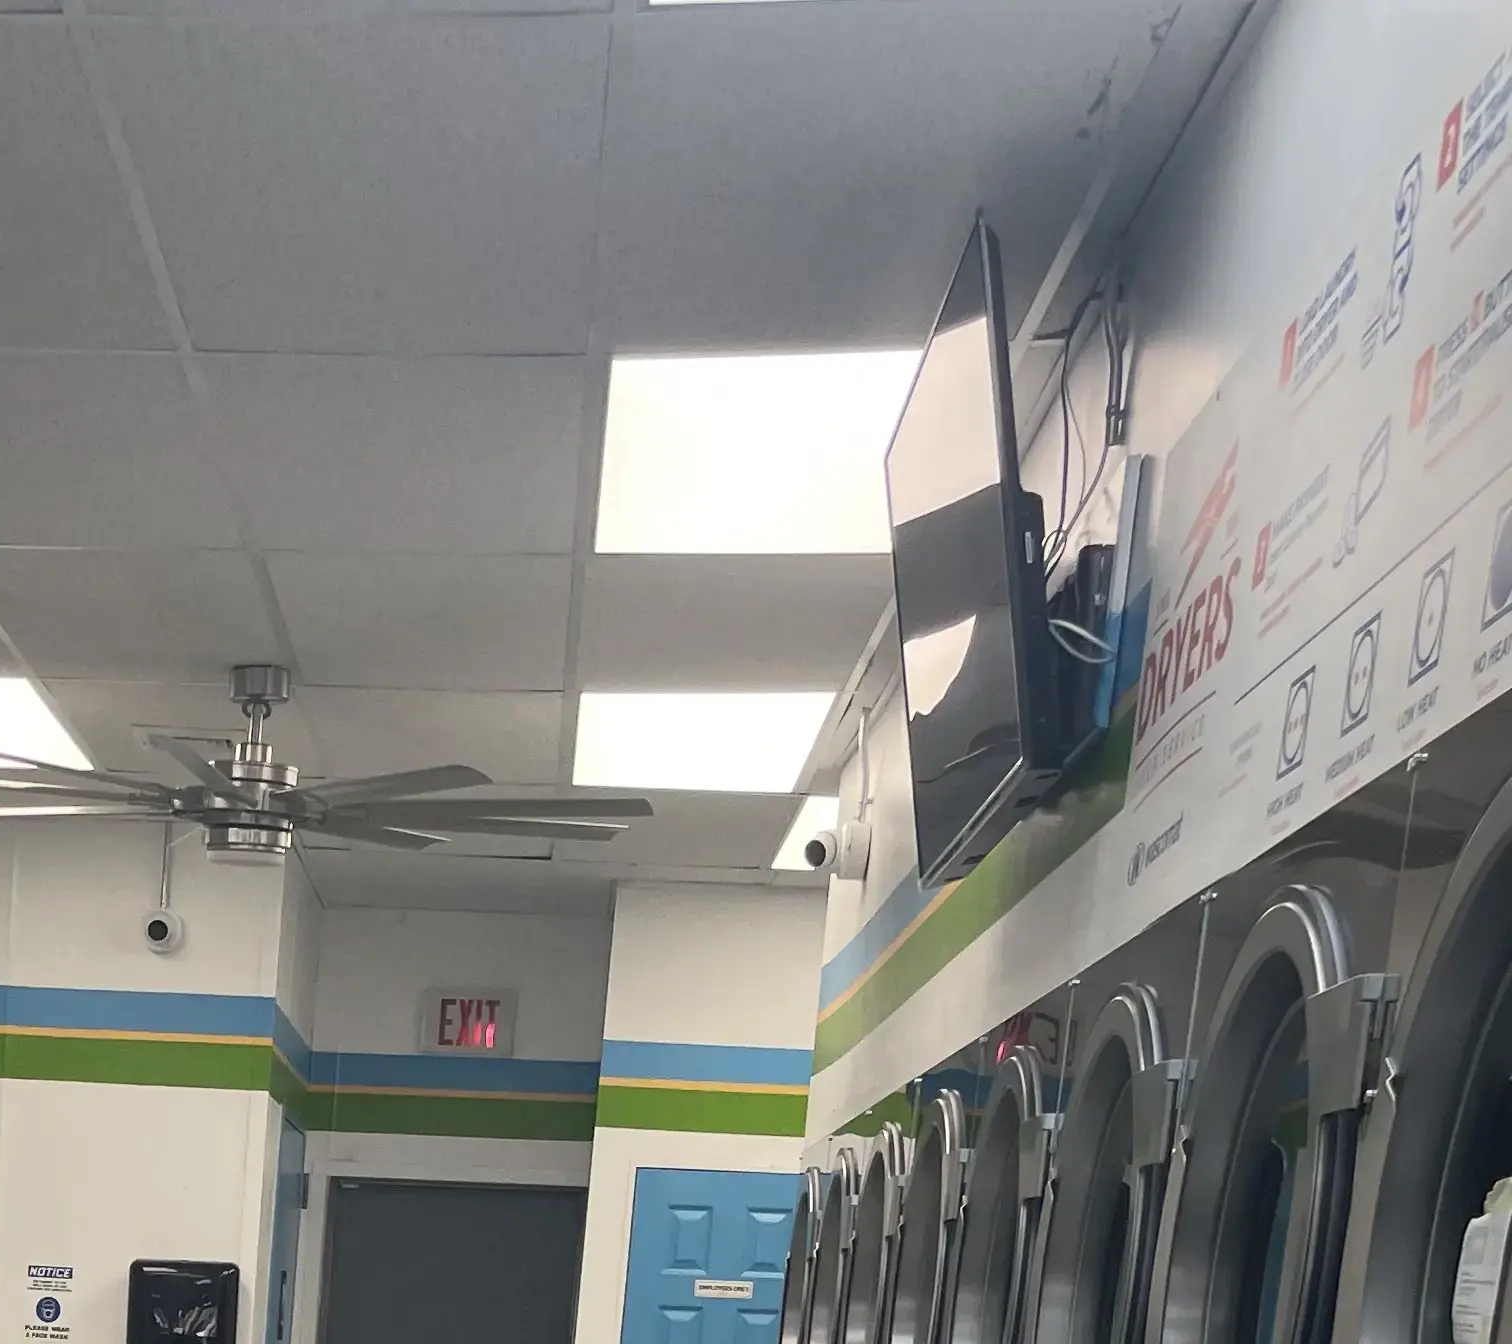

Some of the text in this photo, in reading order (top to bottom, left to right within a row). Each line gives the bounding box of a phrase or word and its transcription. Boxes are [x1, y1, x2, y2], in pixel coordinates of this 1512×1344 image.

[1137, 555, 1241, 748] DRYERS
[438, 998, 501, 1048] EXIT
[29, 1266, 72, 1278] NOTICE
